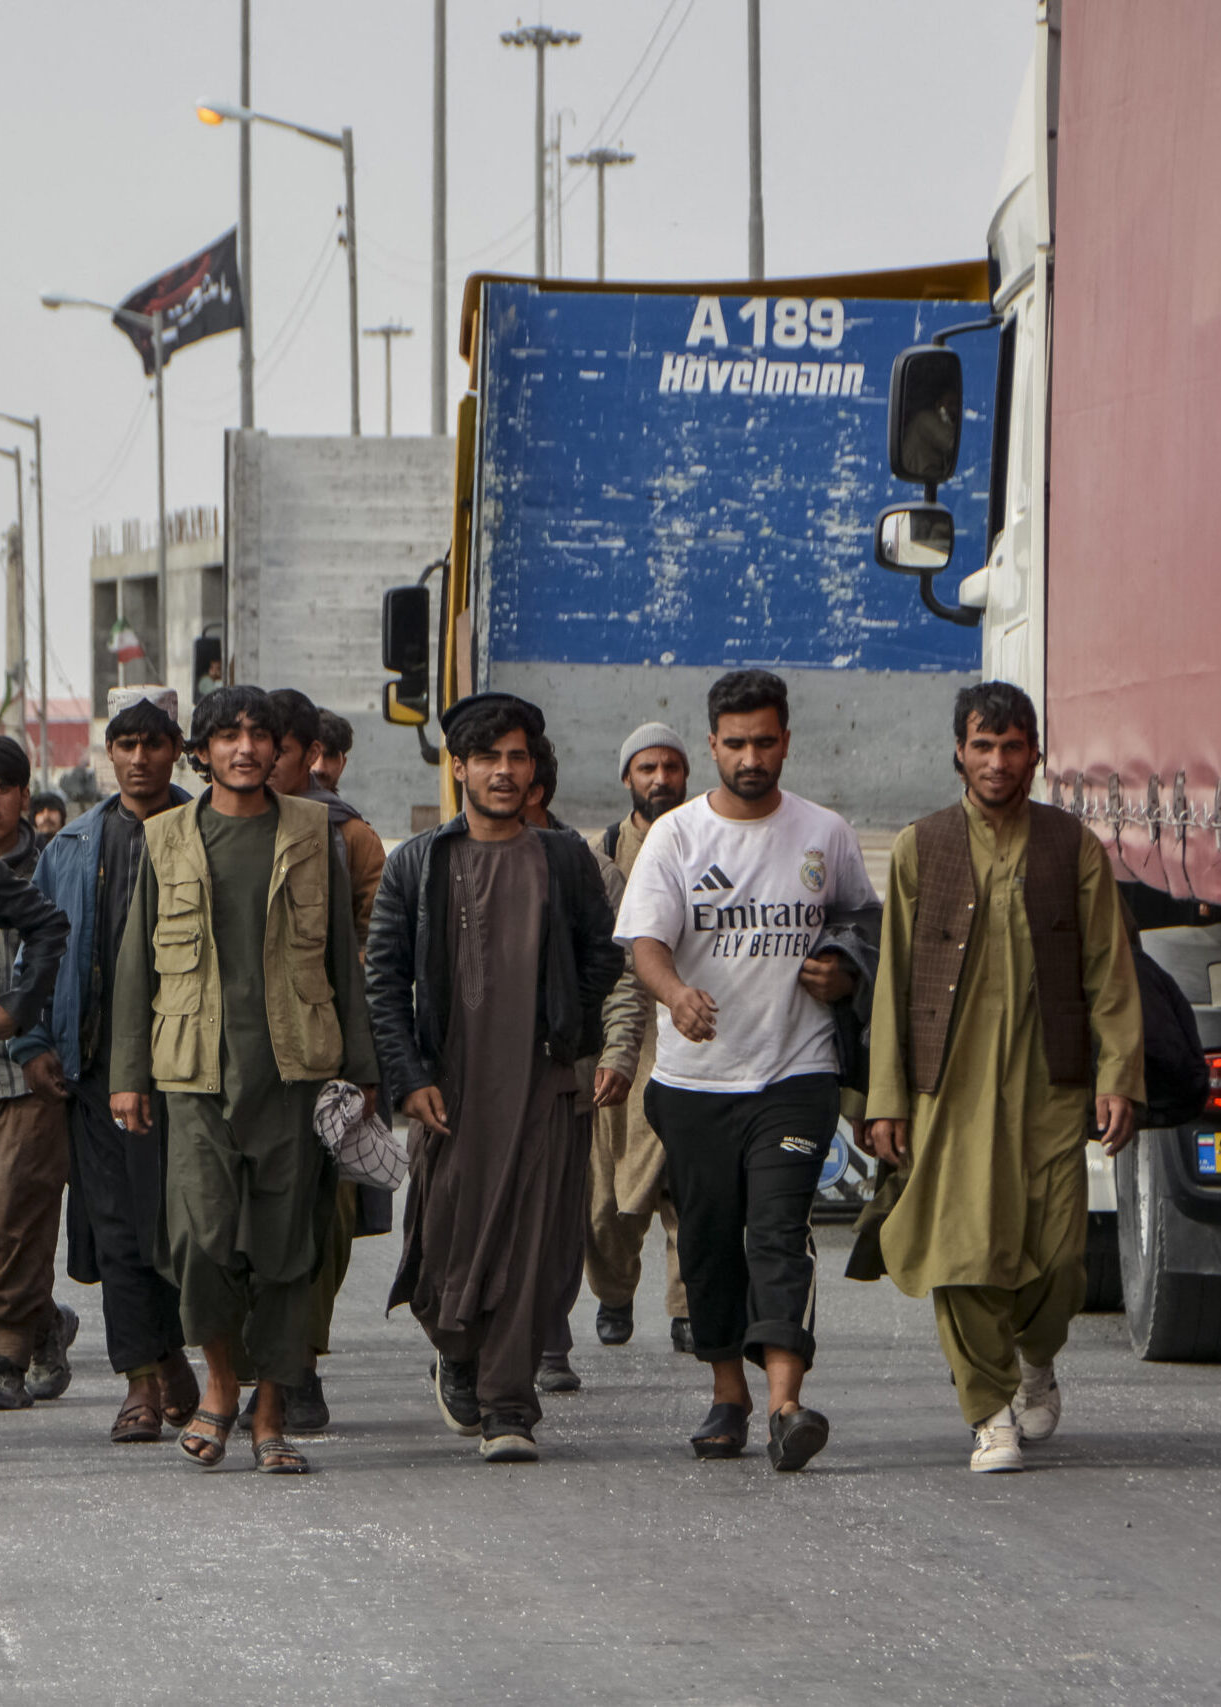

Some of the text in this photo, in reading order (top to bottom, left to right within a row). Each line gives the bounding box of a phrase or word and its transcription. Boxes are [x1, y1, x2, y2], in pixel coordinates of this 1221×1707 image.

[686, 296, 845, 350] A 189
[692, 898, 825, 931] Emirates
[713, 933, 810, 957] FLY BETTER
